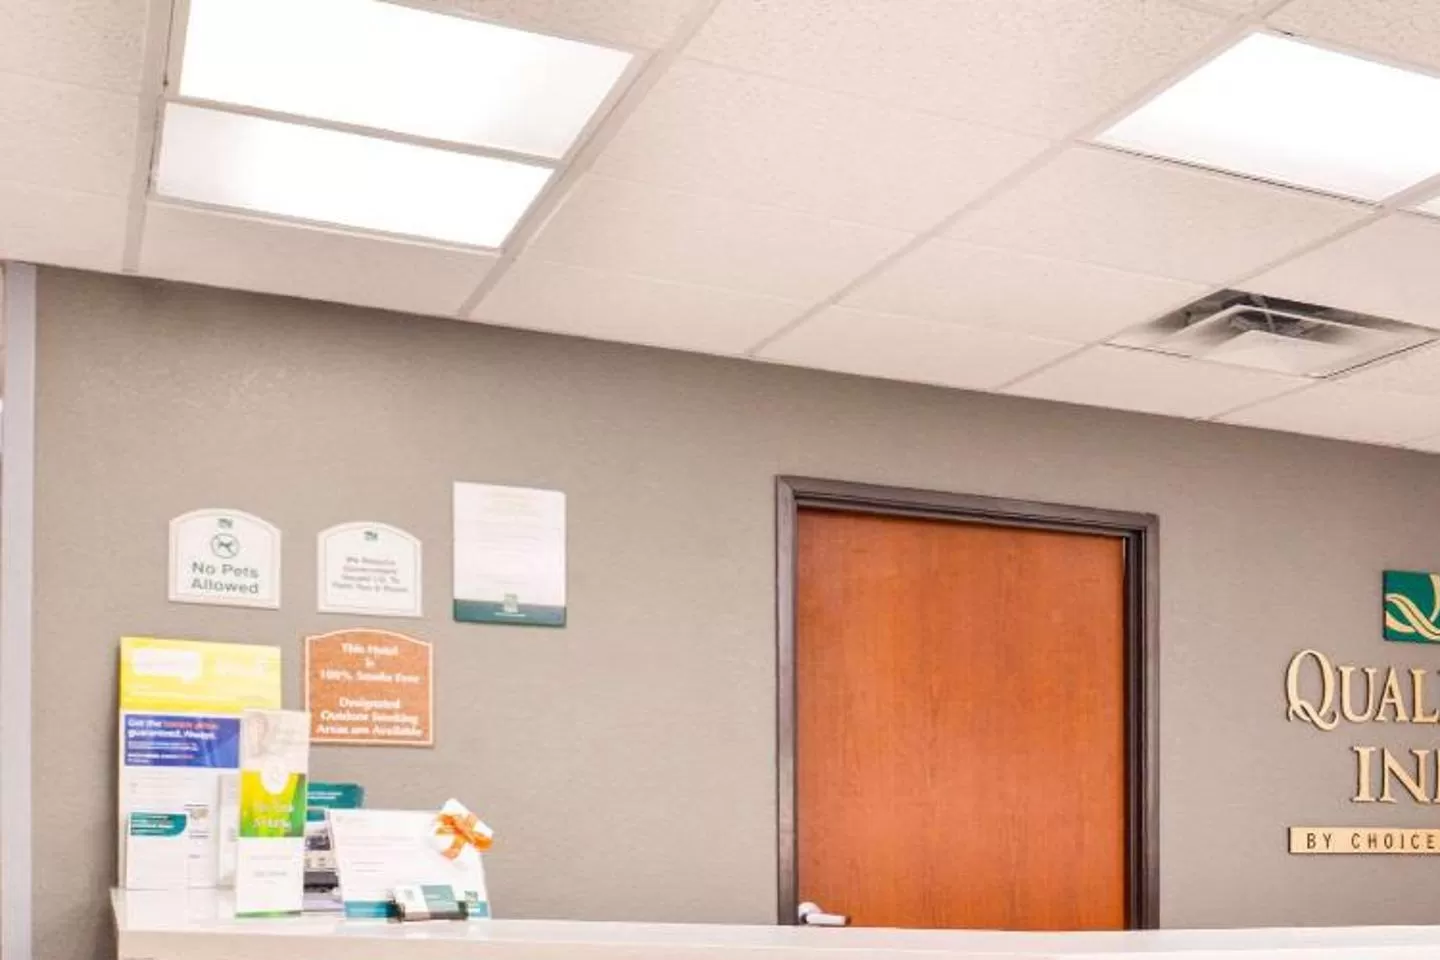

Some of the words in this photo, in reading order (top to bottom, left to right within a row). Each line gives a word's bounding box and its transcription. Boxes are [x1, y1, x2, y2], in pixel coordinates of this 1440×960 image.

[191, 561, 216, 576] No
[221, 563, 260, 579] Pets
[190, 578, 260, 595] Allowed
[1306, 832, 1333, 849] BY
[1351, 832, 1436, 850] CHOICE
